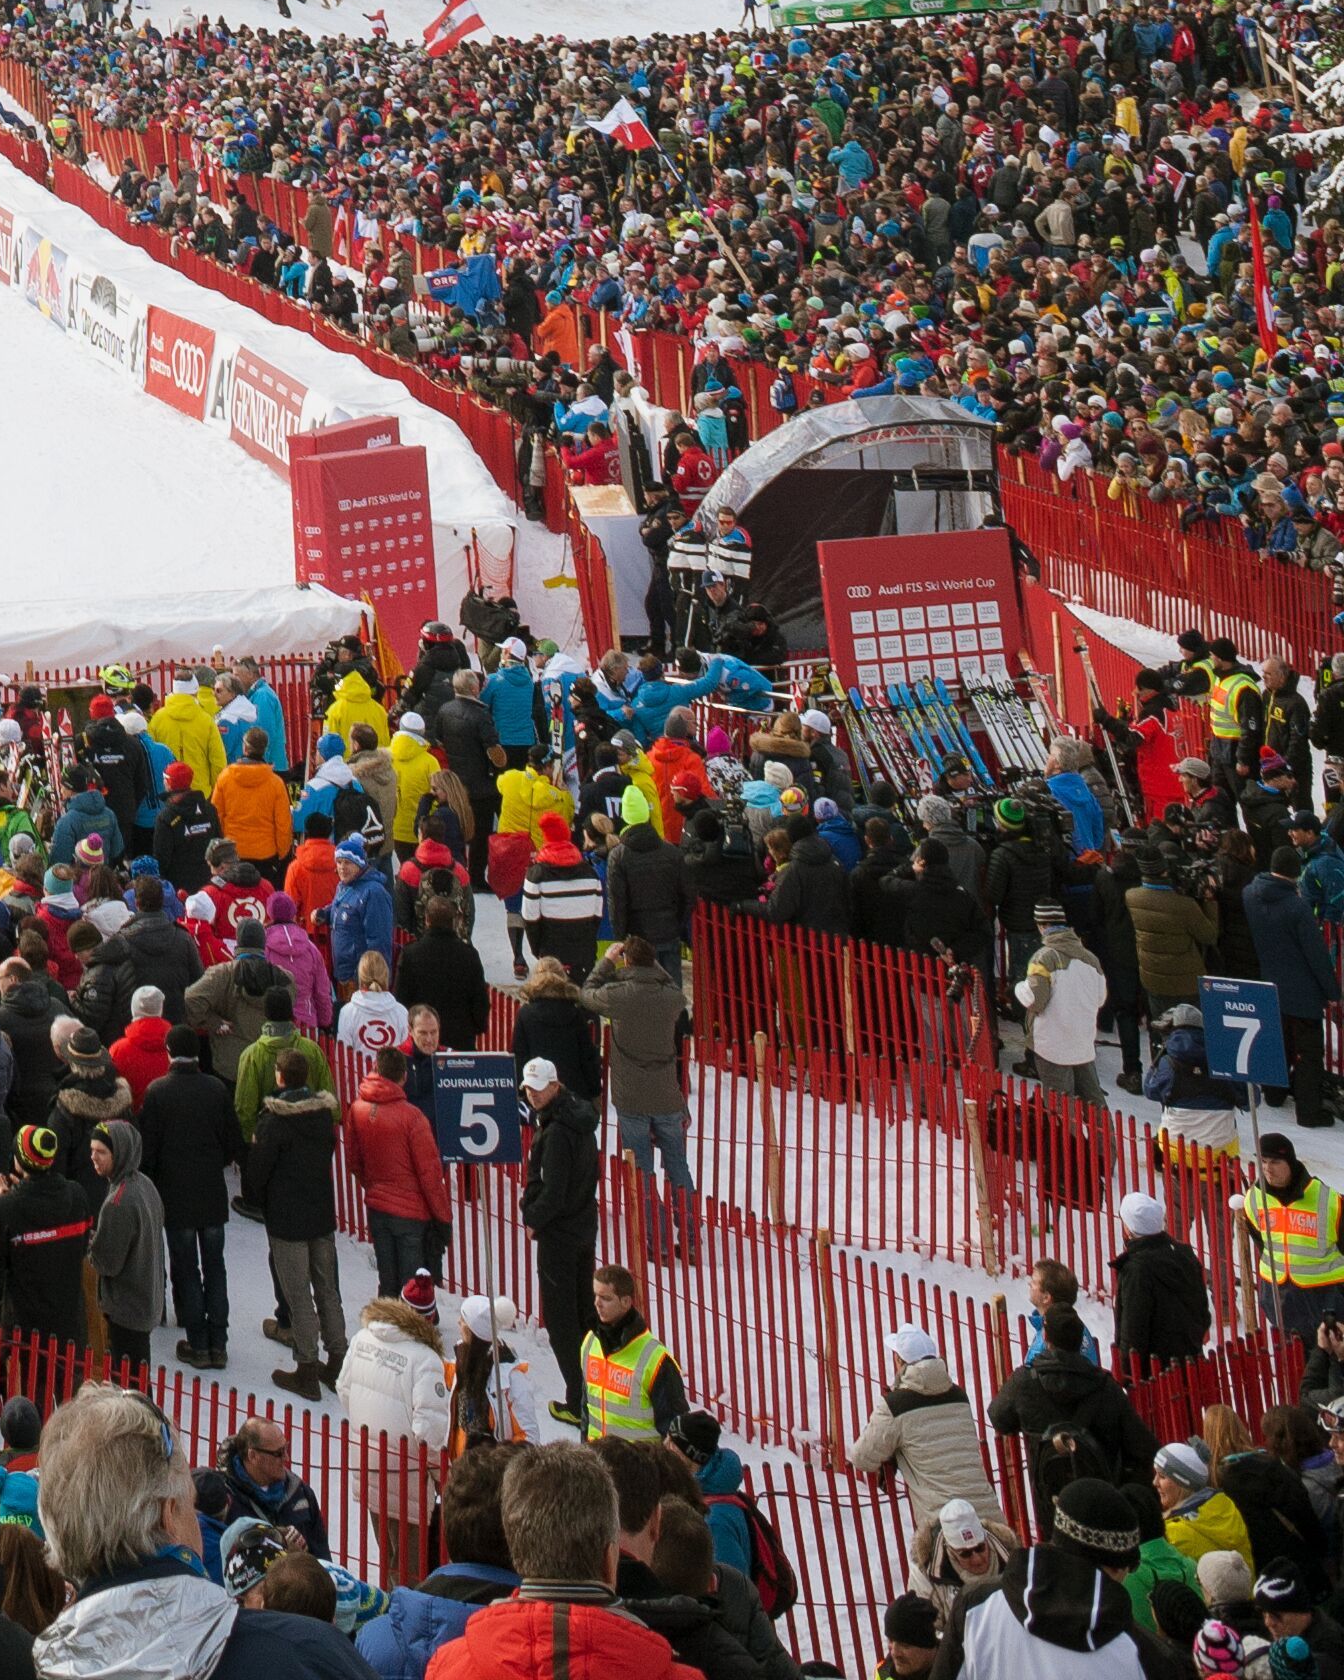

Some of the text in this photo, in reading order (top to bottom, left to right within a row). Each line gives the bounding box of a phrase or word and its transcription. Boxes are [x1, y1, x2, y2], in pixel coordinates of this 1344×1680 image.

[352, 490, 422, 508] Audi FIS Ski World Cup
[878, 578, 996, 596] Audi FIS Ski World Cup
[1224, 1001, 1256, 1012] RADIO
[1222, 1015, 1261, 1075] 7
[437, 1078, 514, 1089] JOURNALISTEN
[459, 1093, 500, 1156] 5
[608, 1370, 632, 1386] VGM
